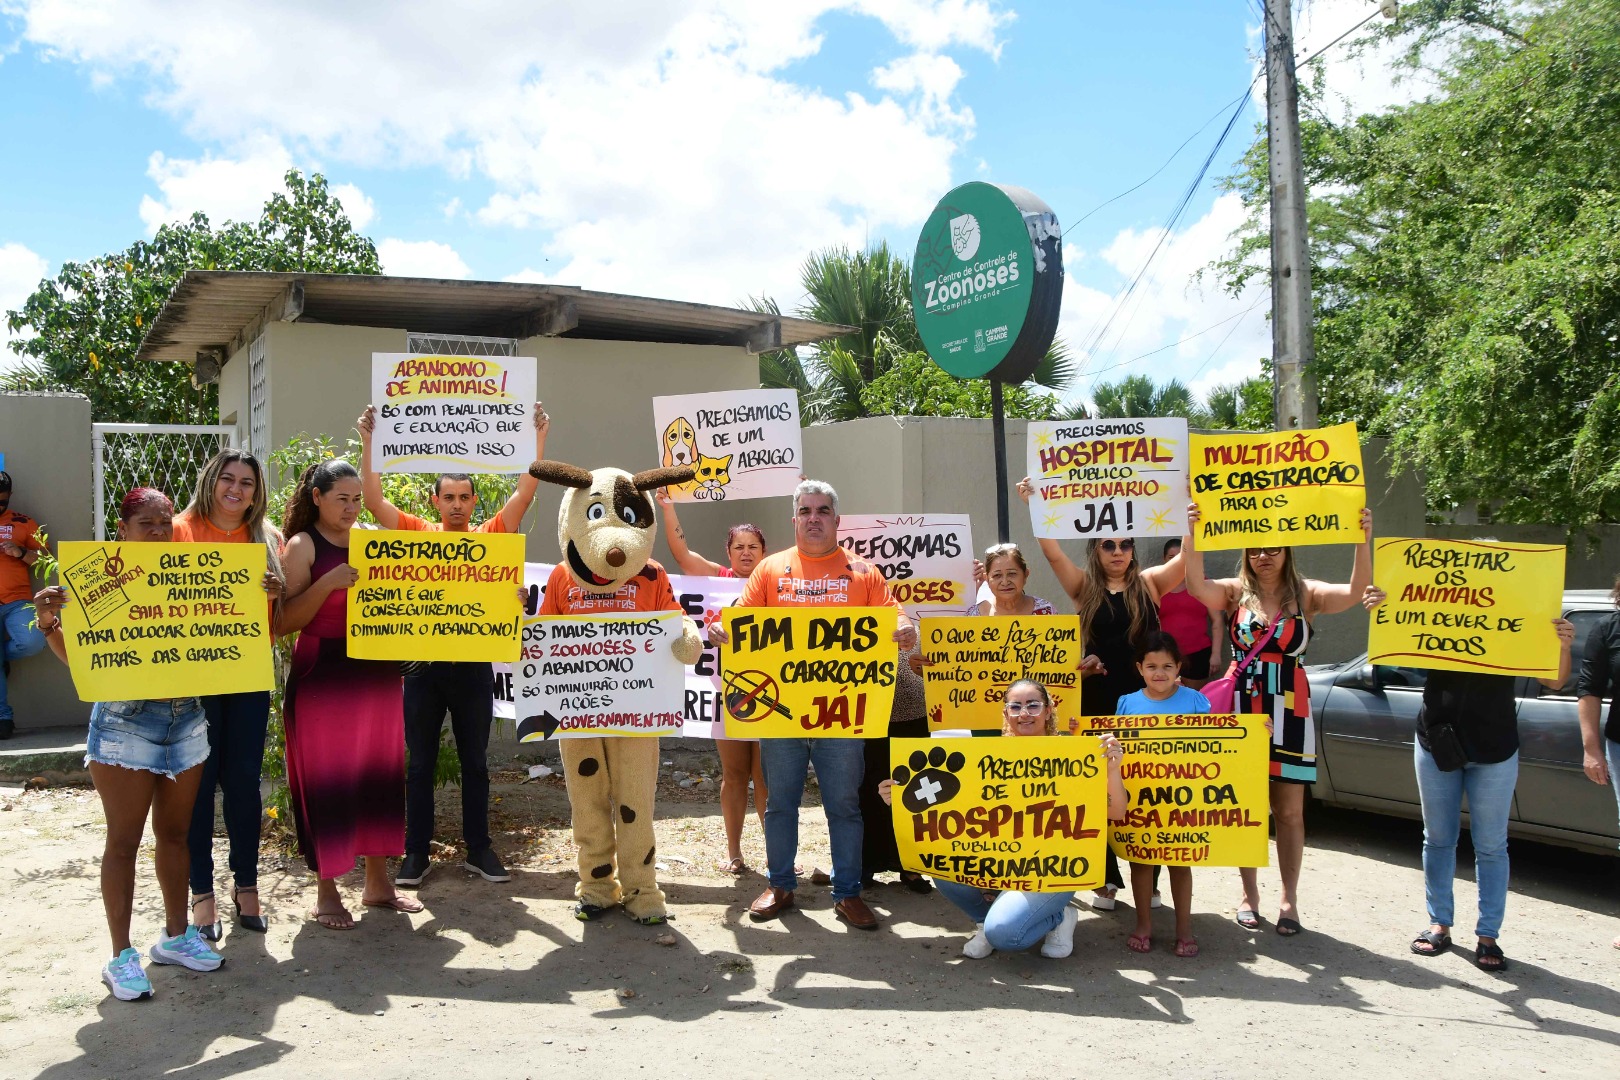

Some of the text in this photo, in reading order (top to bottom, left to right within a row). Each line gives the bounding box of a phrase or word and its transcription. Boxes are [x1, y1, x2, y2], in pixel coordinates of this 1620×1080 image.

[938, 250, 1018, 284] Centro de Controle de
[924, 262, 1020, 308] Zoonoses
[942, 289, 1000, 311] Campina Grande
[985, 325, 1008, 336] CAMPINA
[987, 332, 1008, 342] GRANDE
[394, 360, 486, 378] ABANDONO
[386, 371, 507, 397] DE ANIMAIS!
[381, 404, 525, 418] SÓ COM PENALIDADES
[697, 402, 791, 429] PRECISAMOS
[394, 418, 522, 434] E EDUCAÇÃO QUE
[1056, 422, 1145, 441] PRECISAMOS
[712, 427, 765, 447] DE UM
[383, 442, 515, 457] MUDAREMOS ISSO
[738, 448, 794, 468] ABRIGO
[1039, 438, 1173, 472] HOSPITAL
[1204, 433, 1329, 466] MULTIRÃO
[1194, 461, 1359, 493] DE CASTRAÇÃO
[1040, 477, 1159, 500] VETERINÁRIO
[1220, 494, 1288, 512] PARA OS
[1203, 518, 1272, 539] ANIMAIS
[1278, 517, 1301, 531] DE
[160, 551, 223, 569] QUE OS
[365, 538, 486, 564] CASTRAÇÃO
[1404, 543, 1515, 572] RESPEITAR
[71, 556, 104, 580] DIREITOS
[84, 569, 98, 580] DOS
[148, 569, 250, 587] DIREITOS DOS
[368, 564, 520, 584] MICROCHIPAGEM
[875, 561, 913, 579] OS
[1435, 570, 1467, 586] OS
[80, 571, 109, 592] ANIMAIS
[569, 585, 636, 598] PABA
[778, 574, 848, 591] PARAÍBA
[82, 589, 101, 606] LEI
[167, 585, 233, 601] ANIMAIS
[356, 586, 445, 604] ASSIM É QUE
[892, 581, 954, 603] OSES
[1400, 584, 1495, 607] ANIMAIS
[128, 602, 245, 620] SAIA DO PAPEL
[362, 602, 485, 618] CONSEGUIREMOS
[1377, 605, 1525, 632] É UM DEVER DE
[77, 622, 261, 646] PARA COLOCAR COVARDES
[351, 616, 519, 640] DIMINUIR O ABANDONO!
[522, 619, 668, 642] OS MAUS TRATOS,
[731, 615, 794, 654] FIM
[808, 616, 878, 652] DAS
[931, 629, 942, 643] O
[999, 620, 1042, 650] faz
[1045, 627, 1077, 642] com
[520, 639, 655, 661] AS ZOONOSES E
[1412, 633, 1486, 656] TODOS
[91, 646, 142, 670] ATRÁS
[152, 649, 181, 663] DAS
[927, 650, 950, 664] um
[956, 647, 1009, 665] animal
[523, 657, 633, 678] O ABANDONO
[780, 660, 895, 687] CARROÇAS
[927, 667, 972, 682] muito
[992, 669, 1017, 682] ser
[1022, 665, 1077, 685] humano
[522, 676, 654, 698] SÓ DIMINUIRÃO COM
[560, 693, 613, 711] AÇÕES
[949, 688, 1007, 708] que so
[800, 685, 867, 734] JÁ!
[560, 711, 684, 730] GOVERNAMENTAIS
[1091, 715, 1239, 728] PREFEITO ESTAMOS
[978, 754, 1098, 780] PRECISAMOS
[1121, 761, 1221, 780] UARDANDO
[981, 782, 1060, 800] DE UM
[1138, 786, 1192, 806] ANO
[1203, 784, 1238, 805] DA
[912, 800, 1100, 842] HOSPITAL
[1168, 808, 1262, 827] ANIMAL
[952, 841, 1021, 852] PUBLICO
[1114, 831, 1211, 844] QUE O SENHOR
[1126, 845, 1209, 862] PROMETEU!
[919, 850, 1089, 878] VETERINÁRIO
